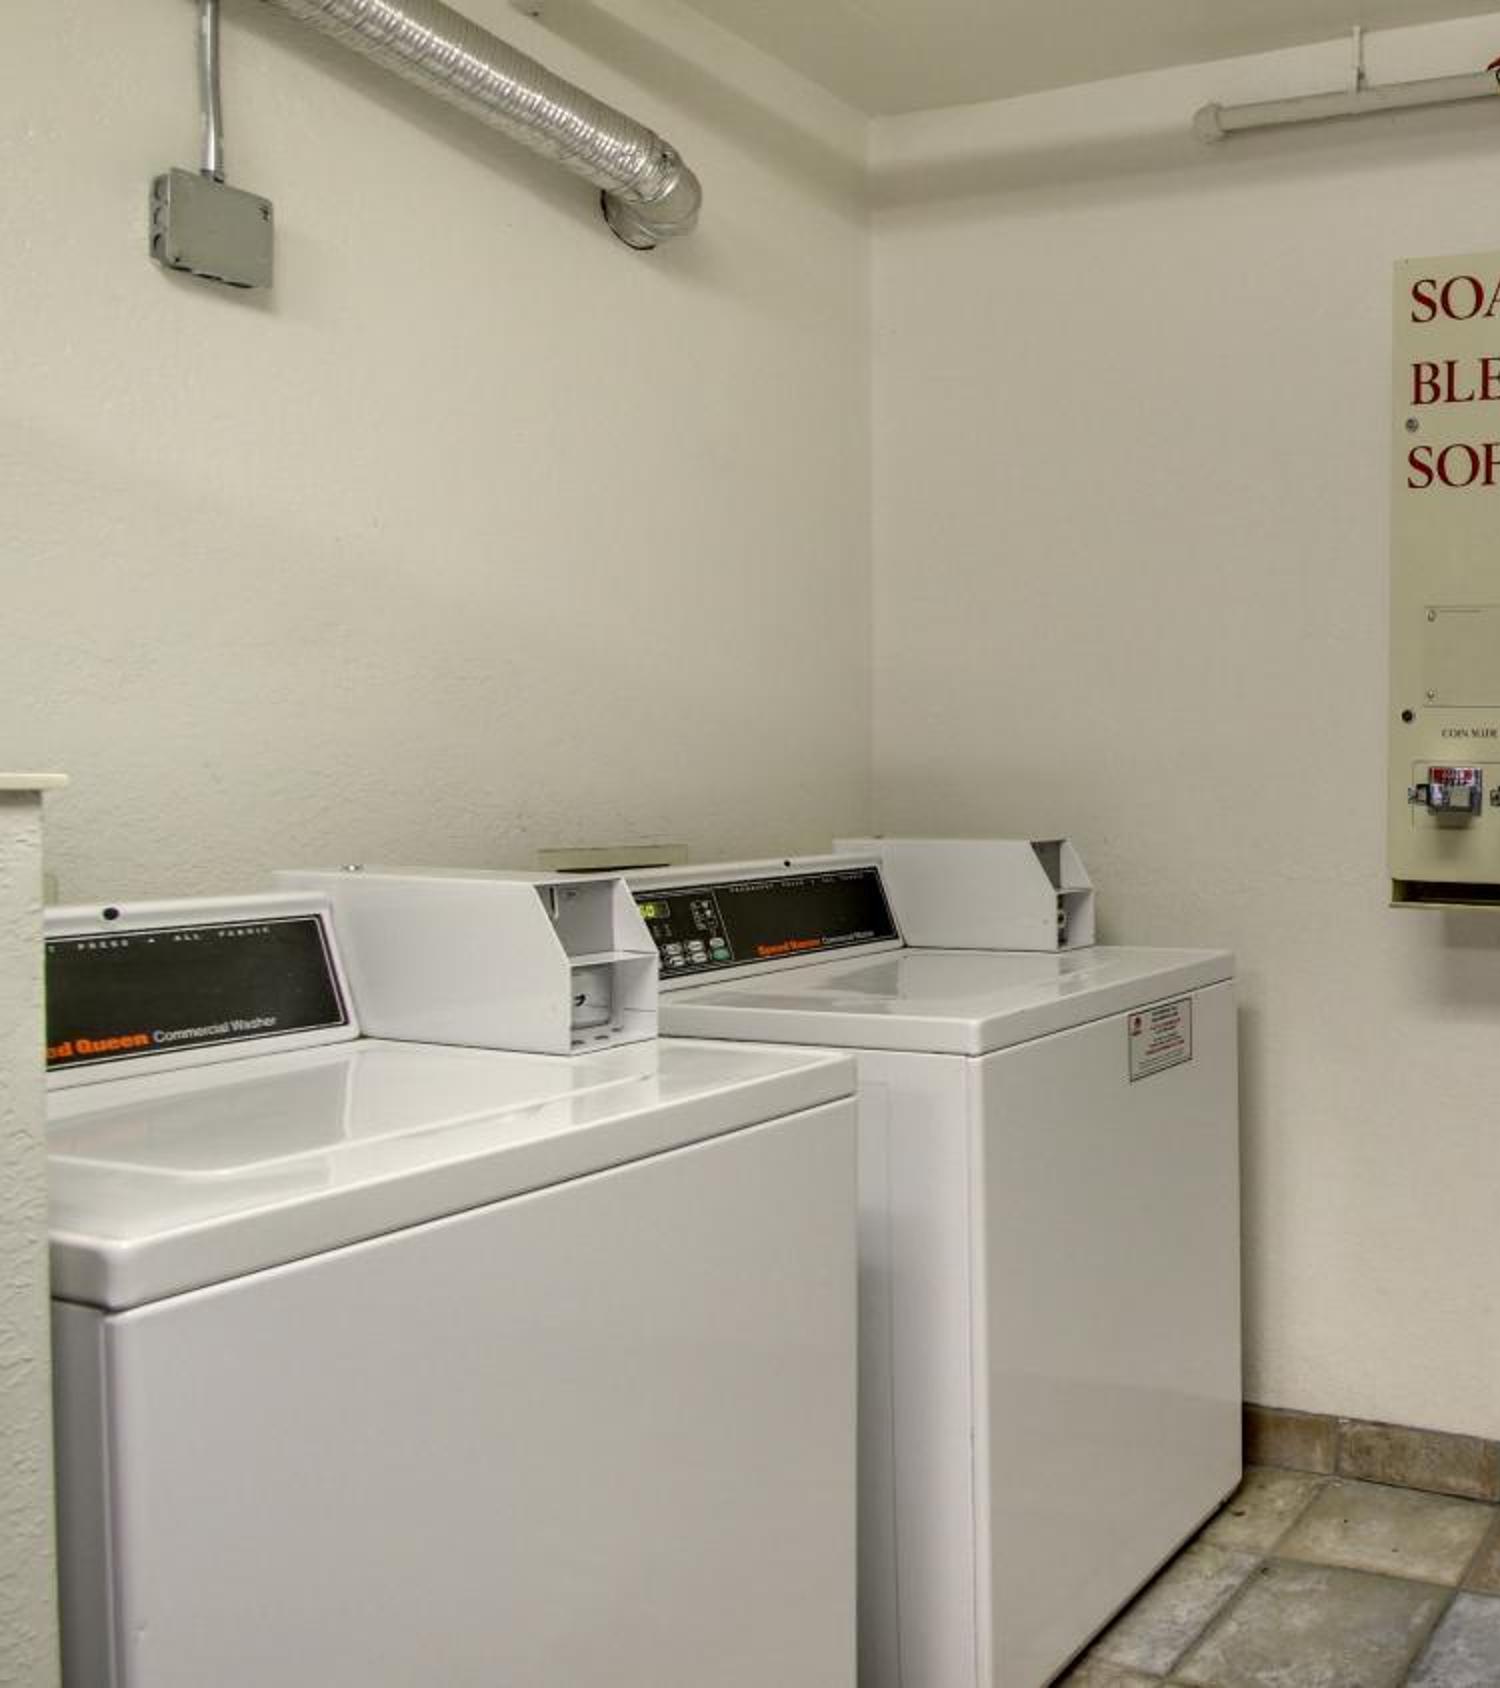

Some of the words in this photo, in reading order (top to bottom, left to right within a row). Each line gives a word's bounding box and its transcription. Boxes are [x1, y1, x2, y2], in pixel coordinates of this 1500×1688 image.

[76, 1033, 149, 1054] Queen
[153, 1021, 230, 1043] Commercial
[232, 1015, 277, 1033] Washer
